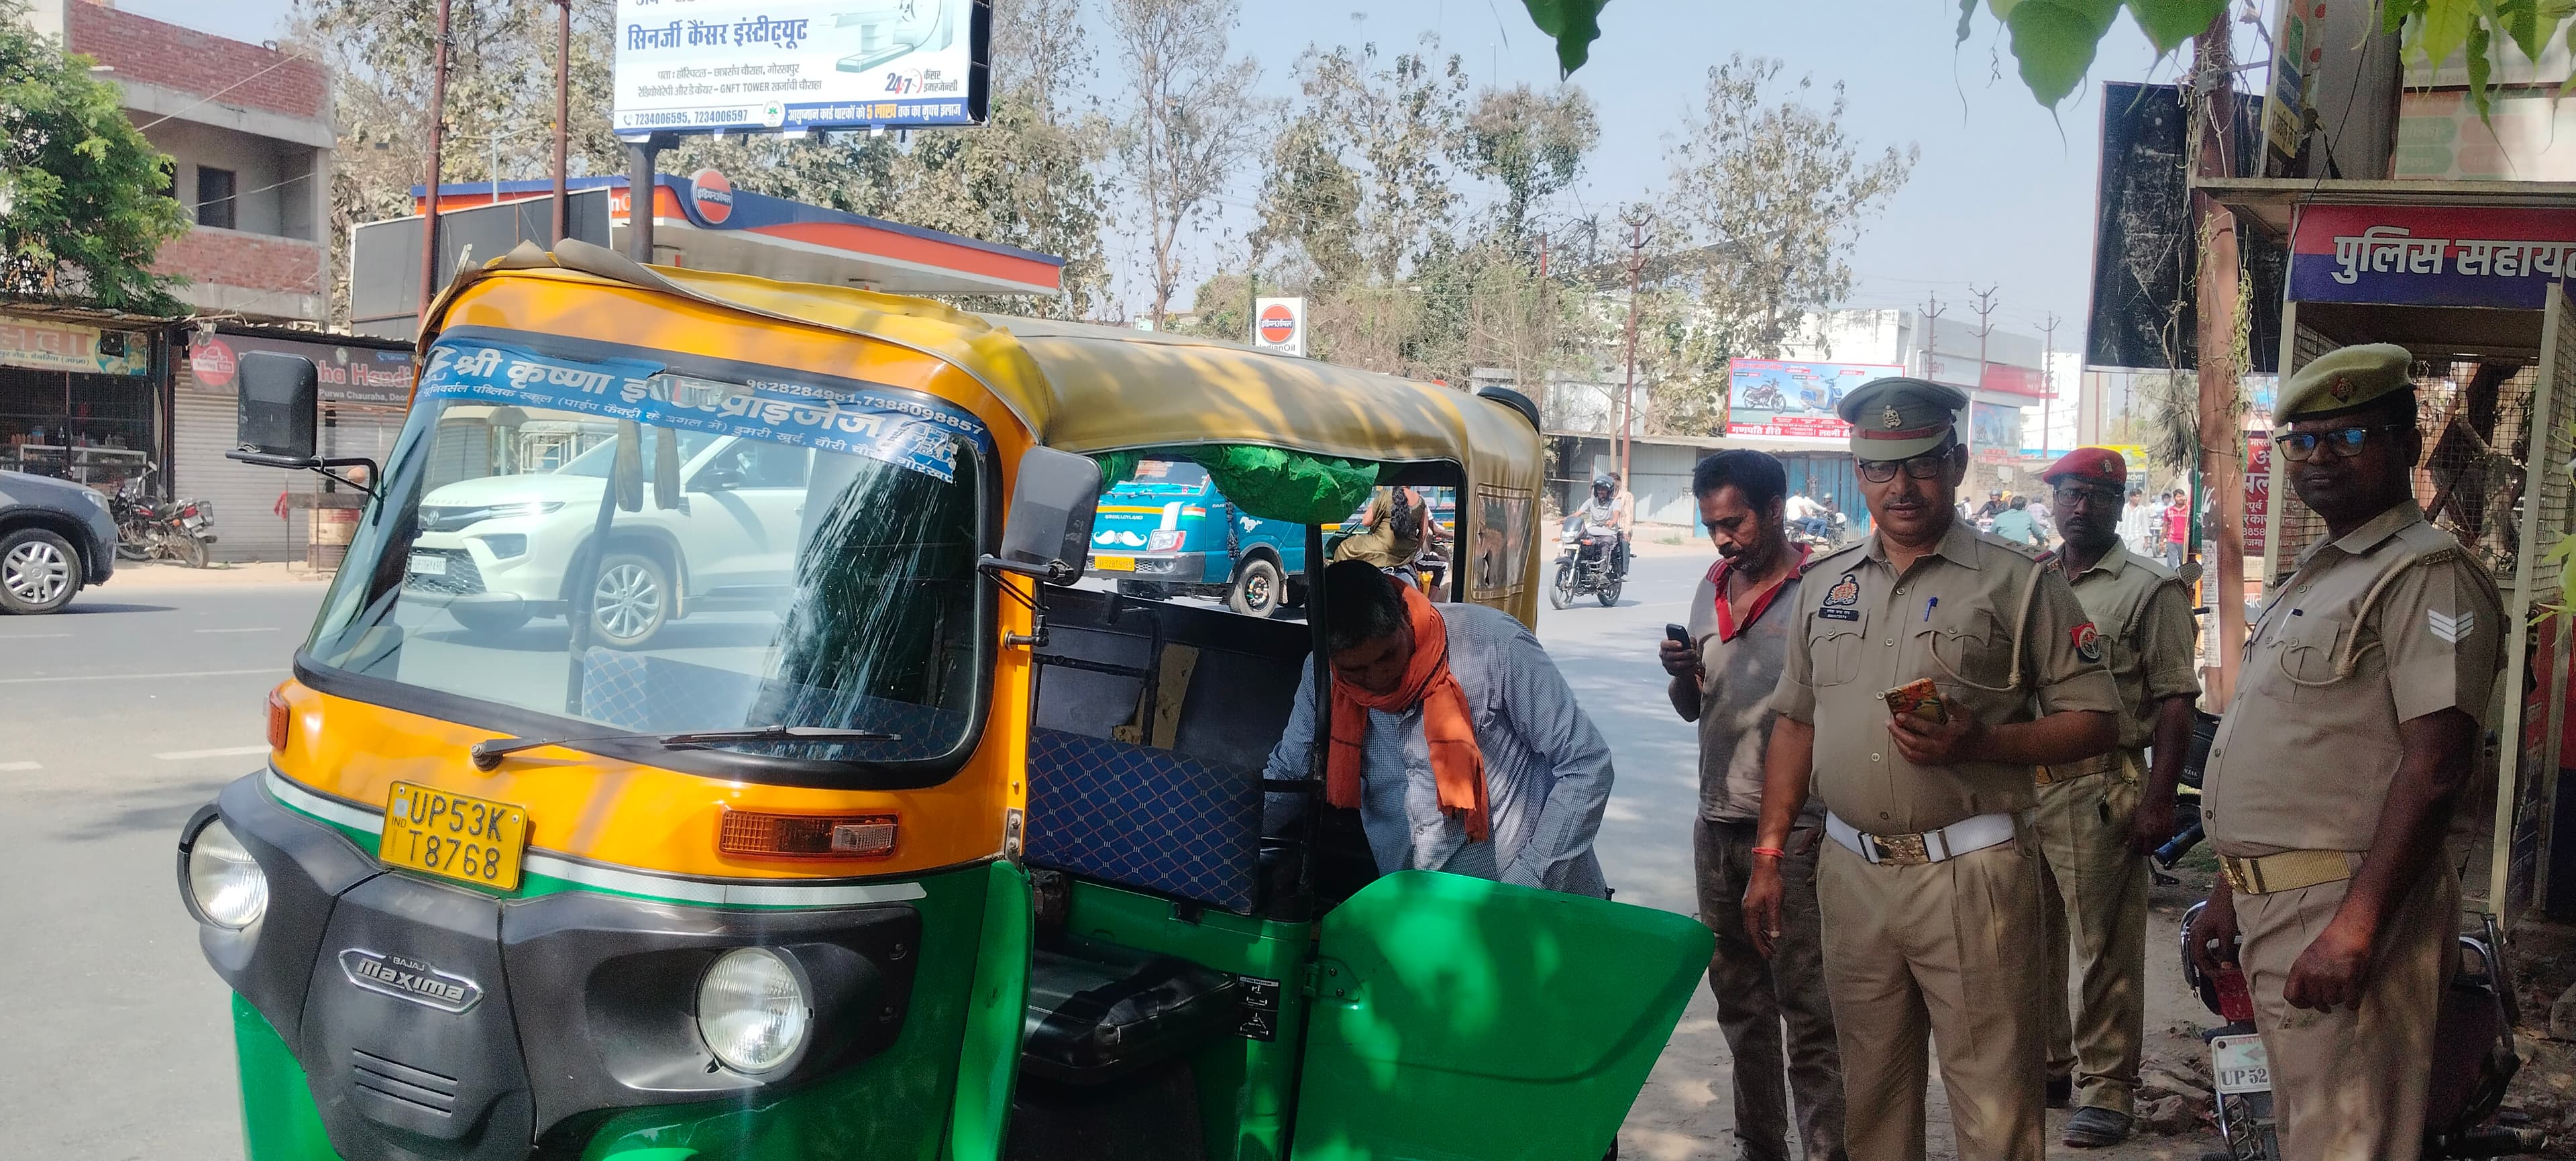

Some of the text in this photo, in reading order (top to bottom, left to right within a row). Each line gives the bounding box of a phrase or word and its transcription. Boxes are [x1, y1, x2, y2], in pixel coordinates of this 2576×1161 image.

[628, 15, 809, 50] सिनर्जी कैंसर इंस्टीट्यूट
[720, 83, 741, 93] GNFT
[743, 82, 769, 93] TOWER
[694, 109, 749, 123] 7234006597
[866, 104, 873, 119] 5
[874, 103, 898, 119] लाख
[2330, 226, 2450, 285] पुलिस
[453, 348, 503, 377] श्री
[507, 360, 615, 395] कृष्णा
[473, 383, 516, 397] पब्लिक
[519, 391, 553, 405] स्कूल
[645, 409, 661, 421] के
[814, 437, 847, 452] चौरी
[392, 817, 407, 828] IND
[410, 791, 506, 842] UP53K
[409, 829, 500, 879] T8768
[393, 957, 425, 971] BAJAJ
[2220, 1070, 2245, 1086] UP
